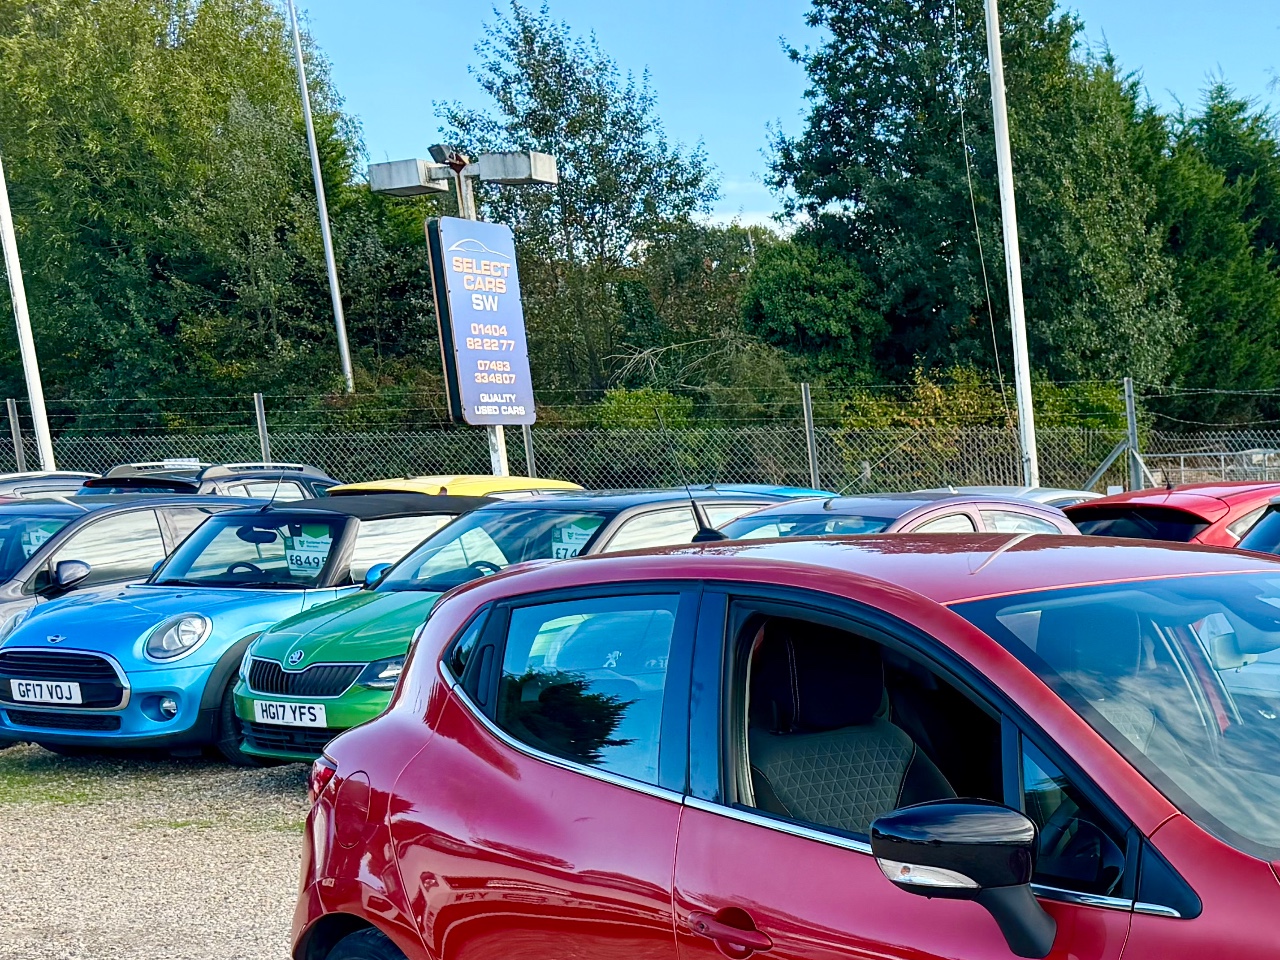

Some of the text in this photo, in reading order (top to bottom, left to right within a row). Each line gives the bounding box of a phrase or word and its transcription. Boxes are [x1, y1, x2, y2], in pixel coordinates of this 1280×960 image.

[452, 256, 511, 278] SELECT
[463, 274, 507, 294] CARS
[471, 293, 499, 311] SW
[470, 323, 507, 336] 01404
[480, 393, 516, 403] QUALITY
[474, 405, 526, 415] USED CARS
[18, 682, 73, 701] GF17 VOJ
[260, 702, 317, 722] HG17 YFS
